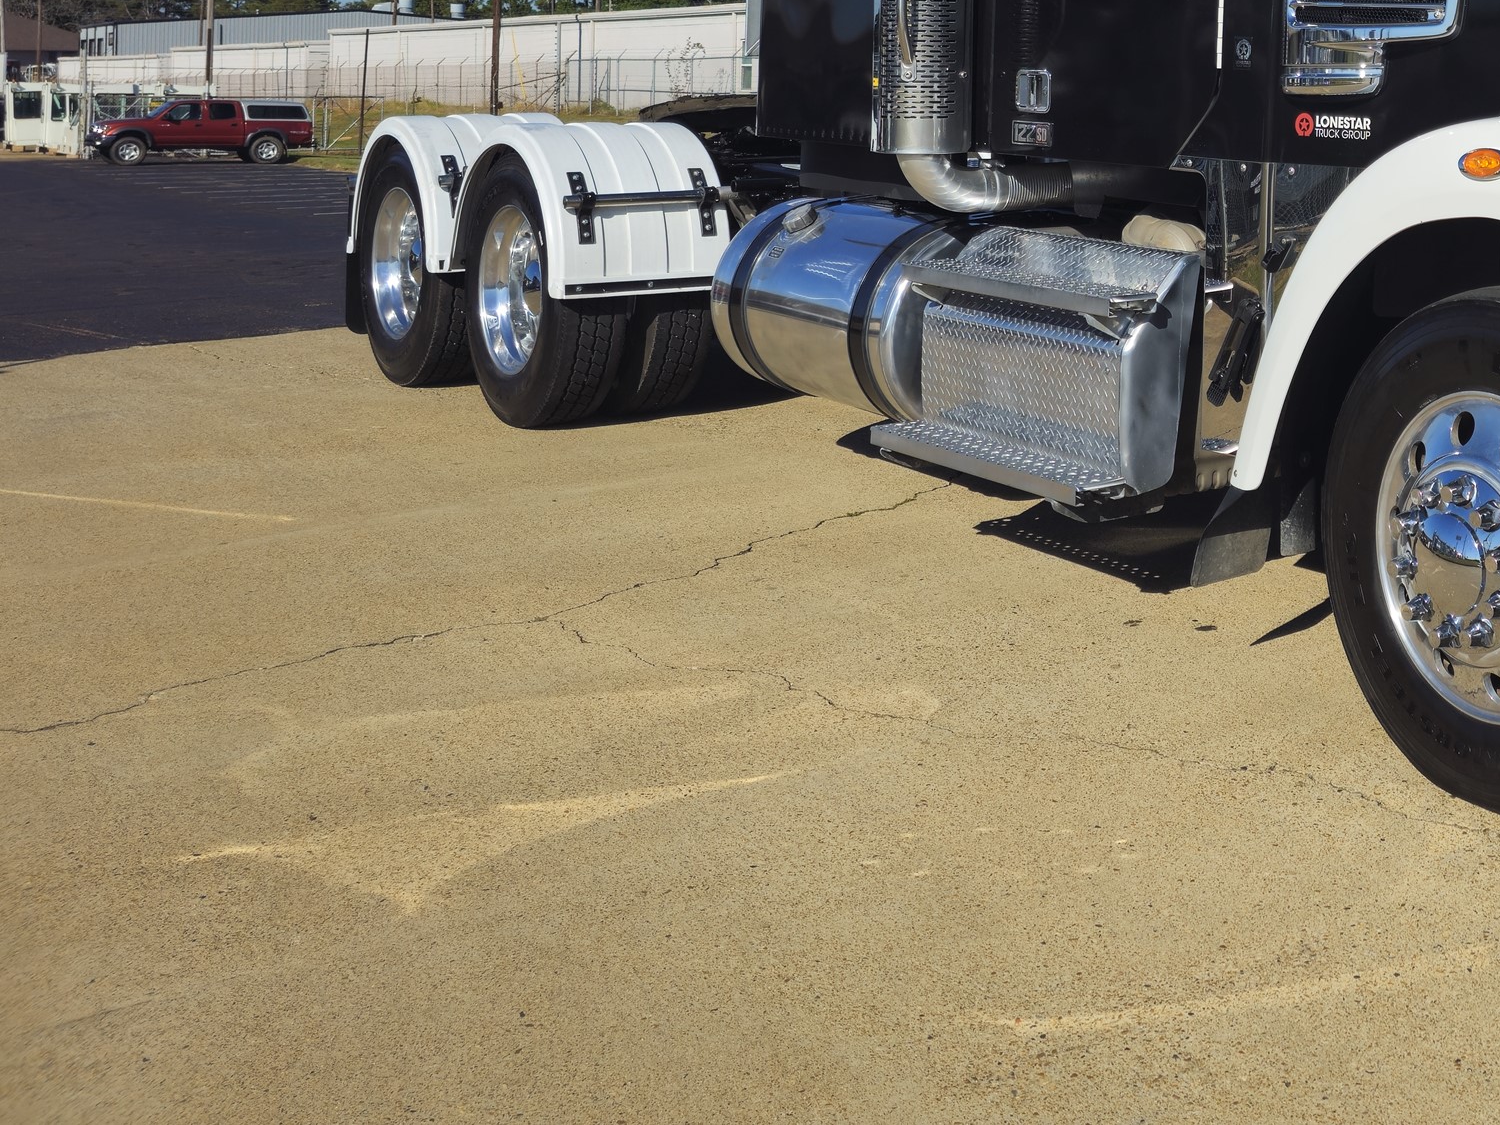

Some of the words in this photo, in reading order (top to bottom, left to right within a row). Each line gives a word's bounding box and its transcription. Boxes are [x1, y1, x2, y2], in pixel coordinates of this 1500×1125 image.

[1315, 115, 1371, 130] LONESTAR
[1315, 127, 1340, 139] TRUCK
[1341, 129, 1371, 140] GROUP
